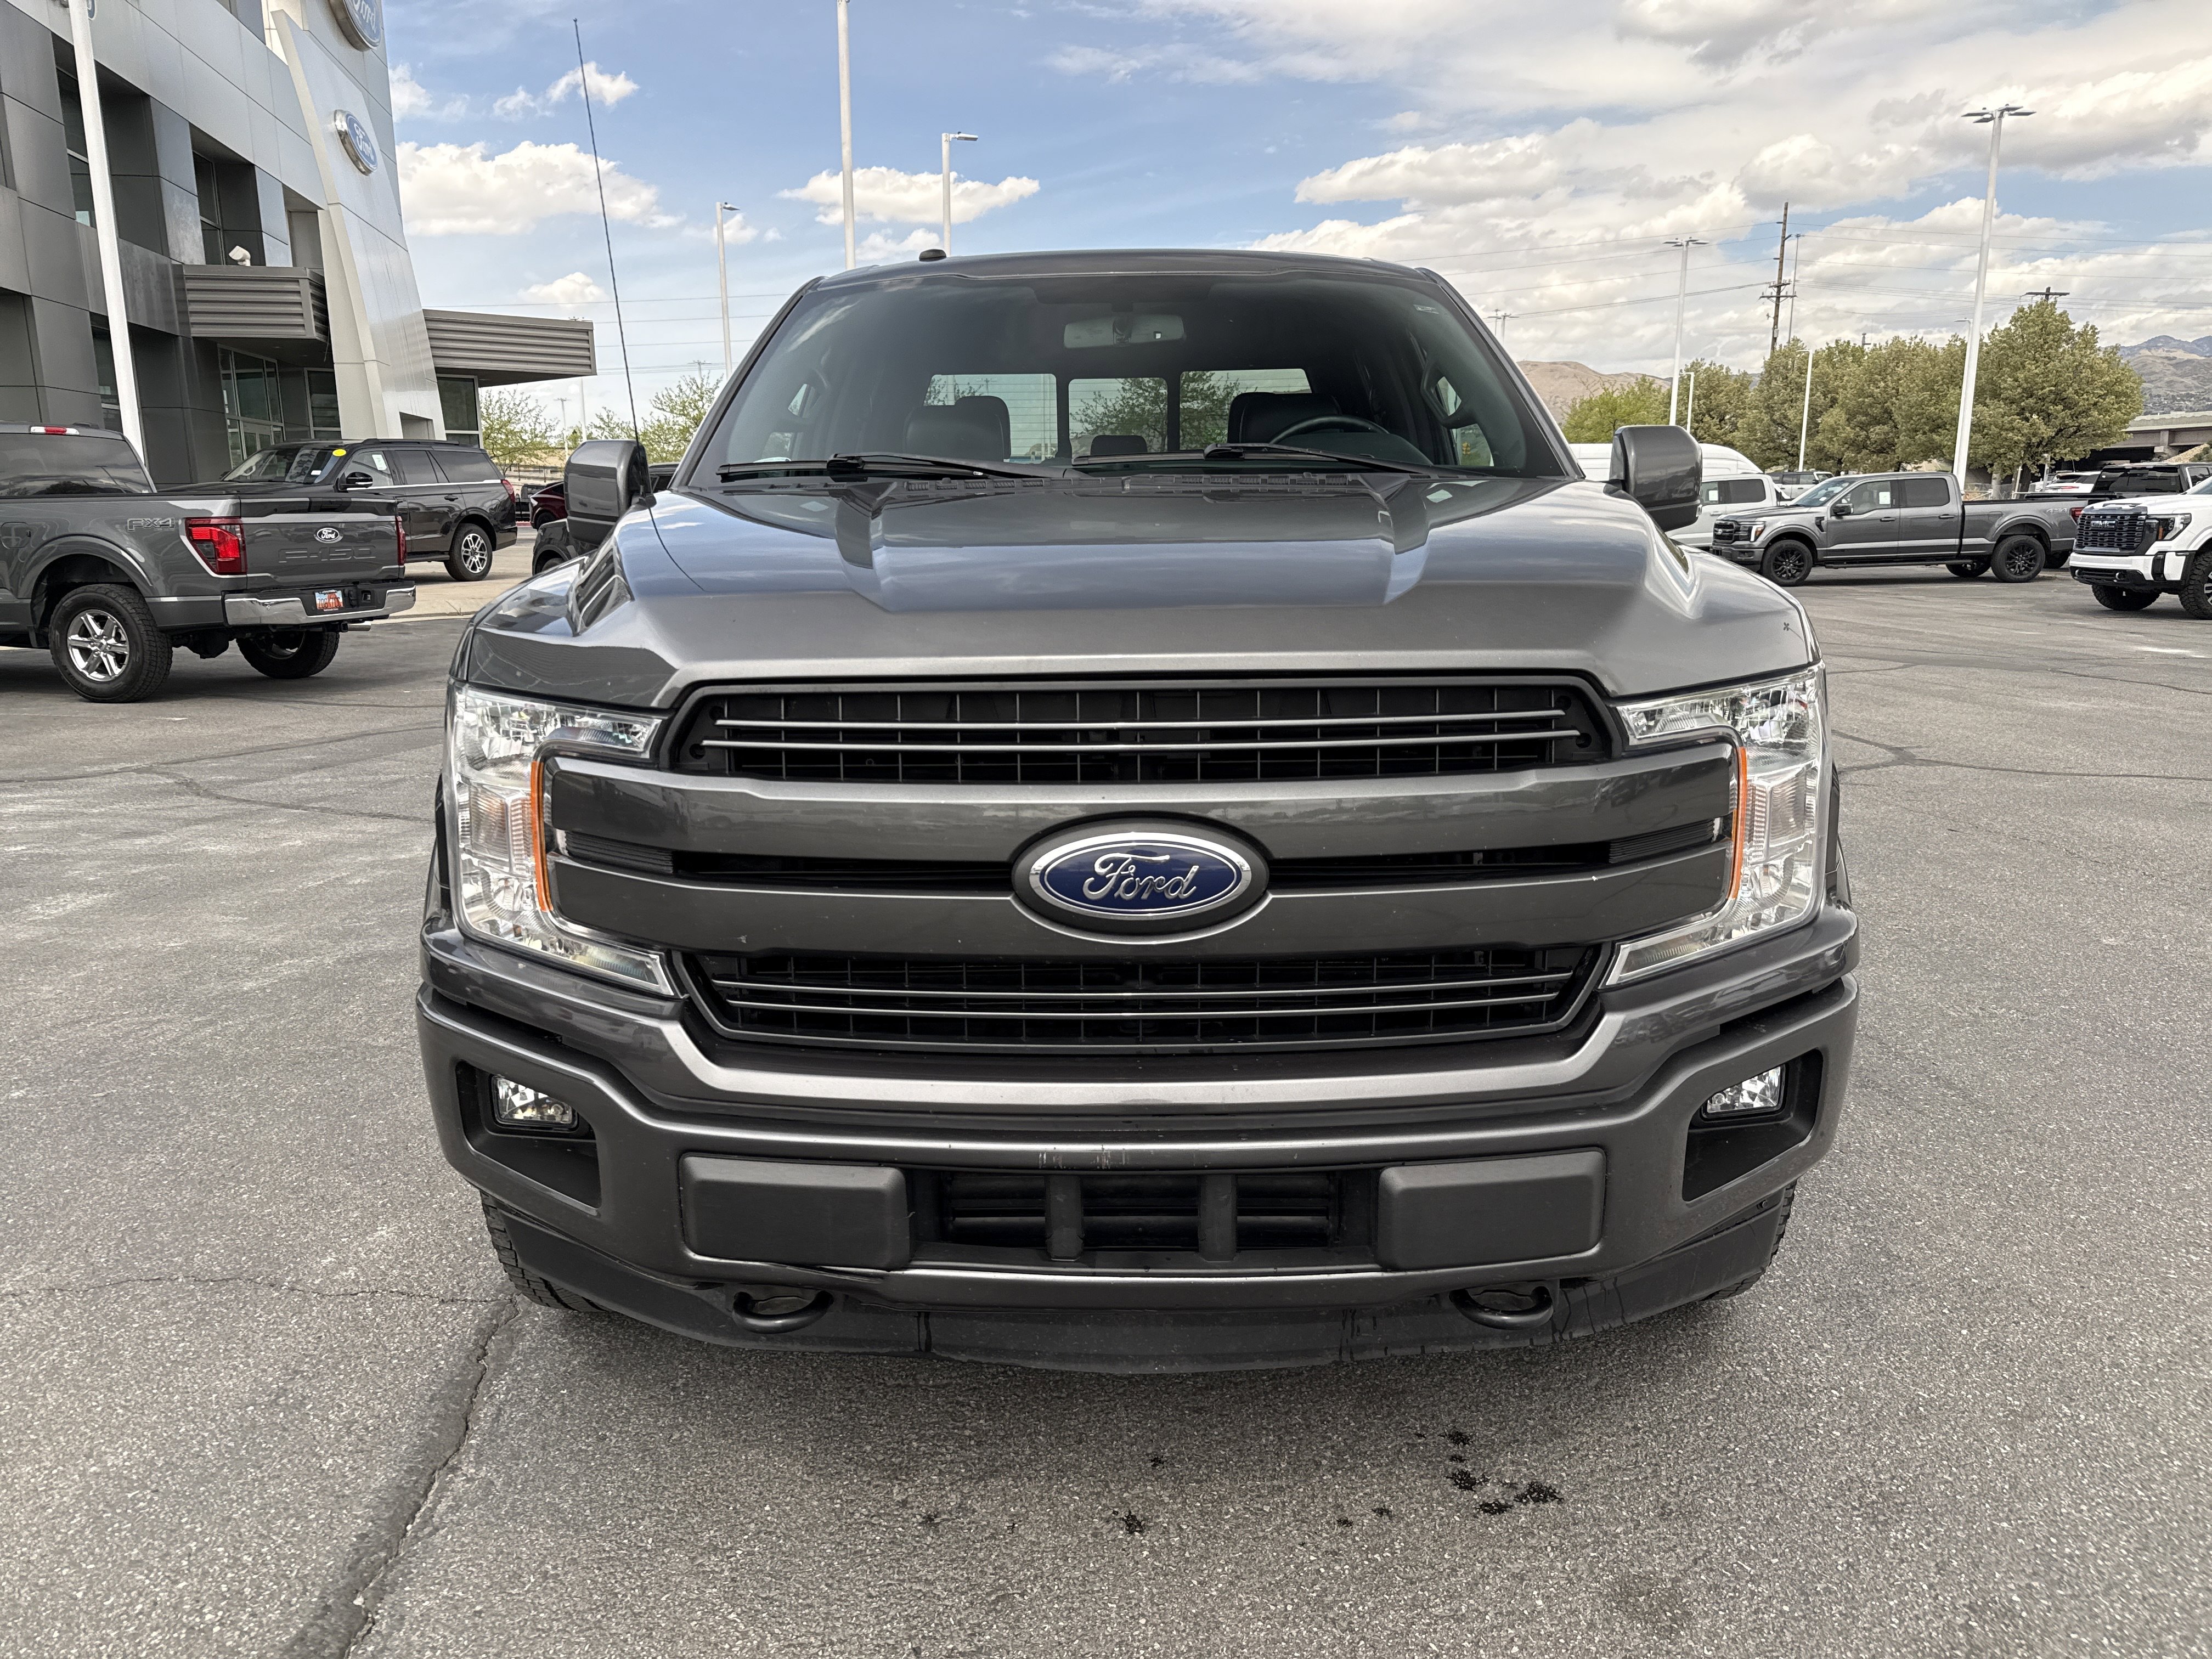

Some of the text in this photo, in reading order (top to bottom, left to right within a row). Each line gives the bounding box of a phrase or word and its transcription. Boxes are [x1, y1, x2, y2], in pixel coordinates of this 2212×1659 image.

[353, 0, 376, 34] ord
[354, 123, 374, 162] Ford
[127, 518, 174, 532] FX4
[2091, 520, 2116, 528] GMC
[321, 529, 336, 539] Ford
[278, 545, 376, 563] F-150
[1082, 853, 1200, 900] Ford
